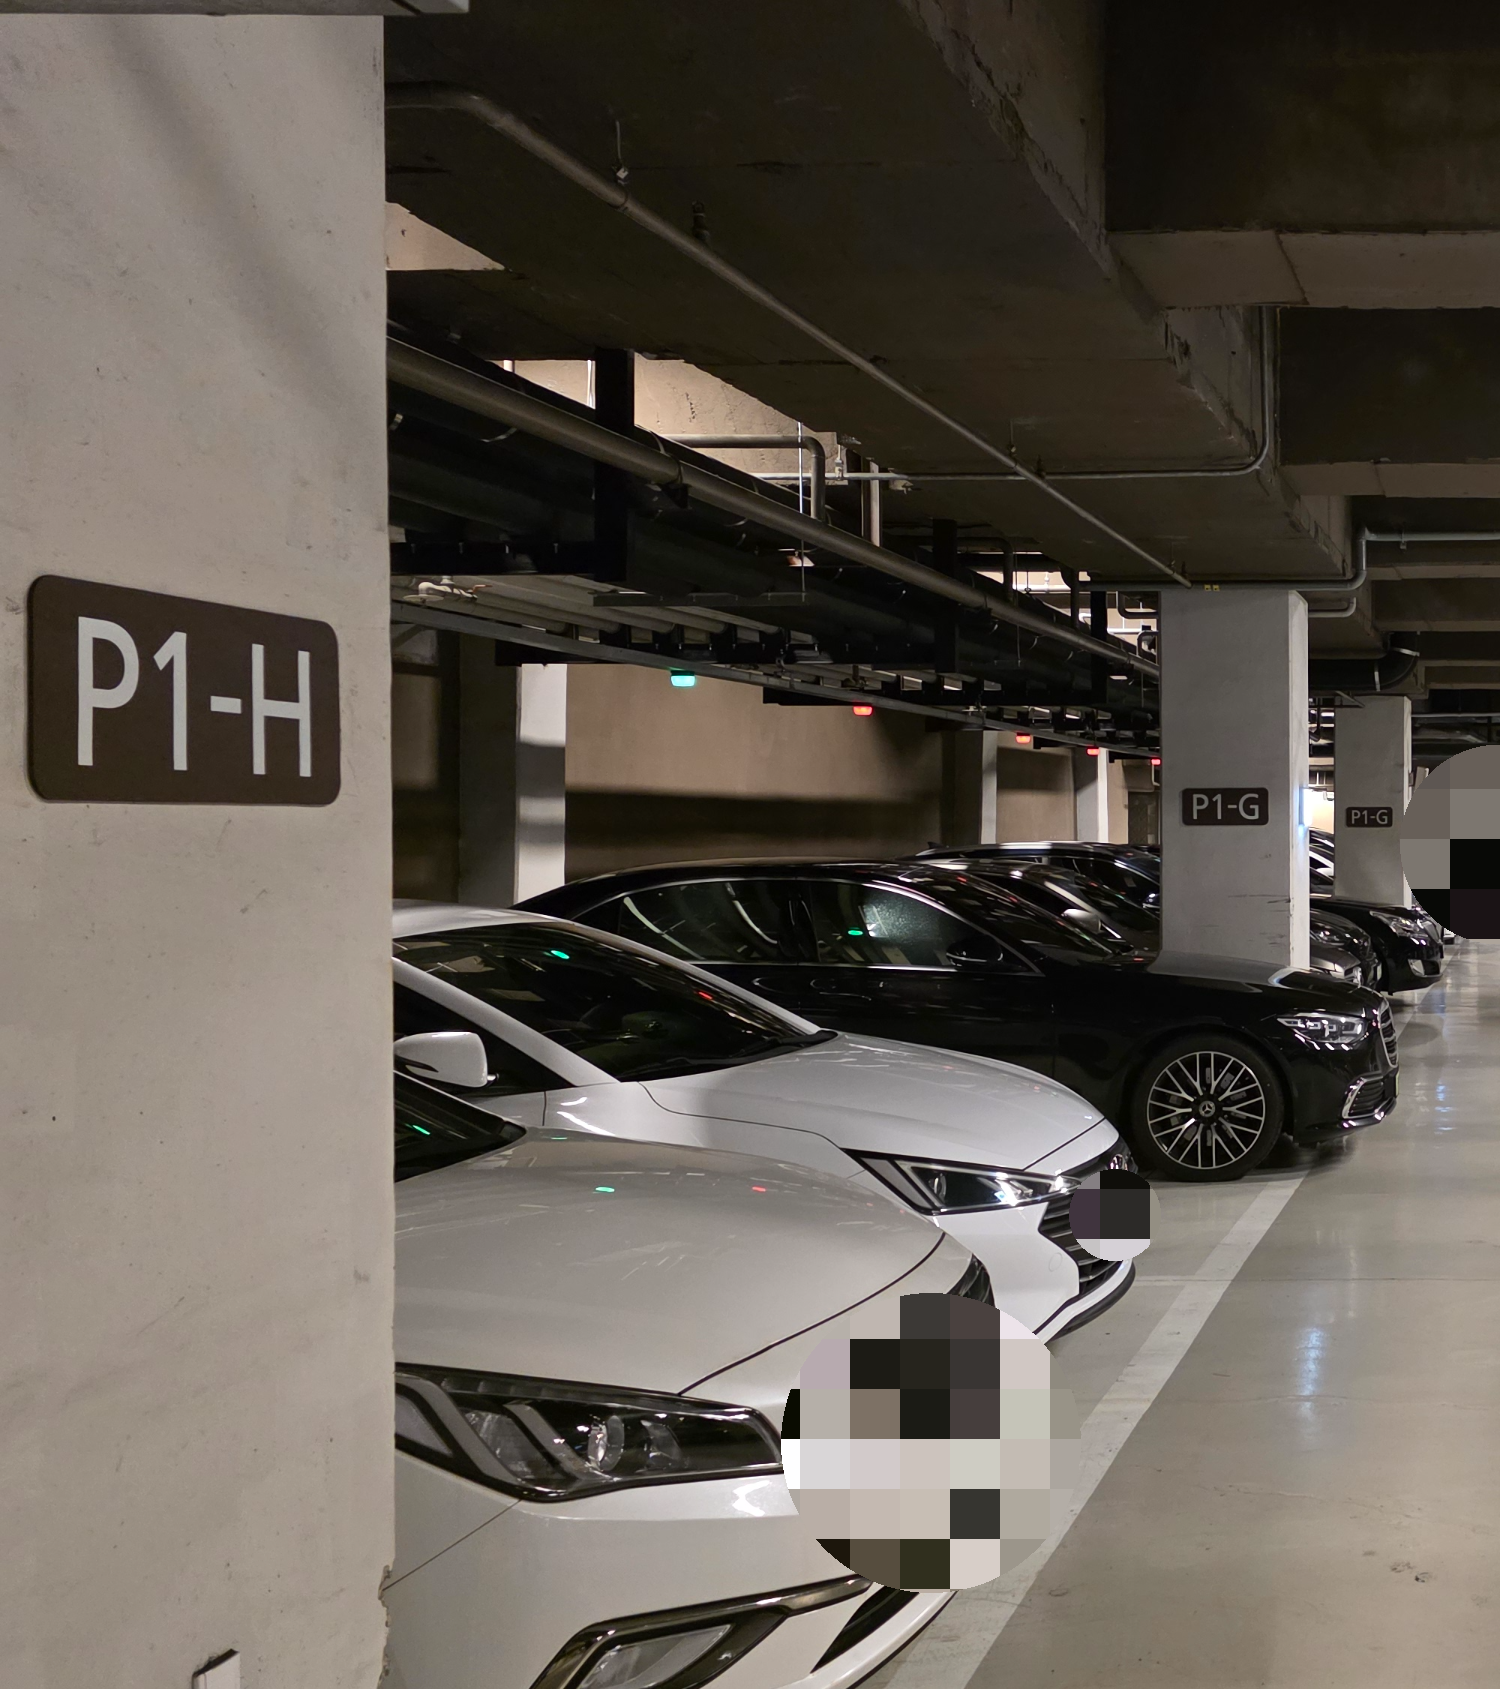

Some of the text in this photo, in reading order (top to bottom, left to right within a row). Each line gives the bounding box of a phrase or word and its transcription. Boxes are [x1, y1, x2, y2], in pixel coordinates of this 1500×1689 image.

[77, 616, 312, 778] P1-H
[1192, 793, 1260, 820] P1-G
[1351, 810, 1388, 825] P1-G
